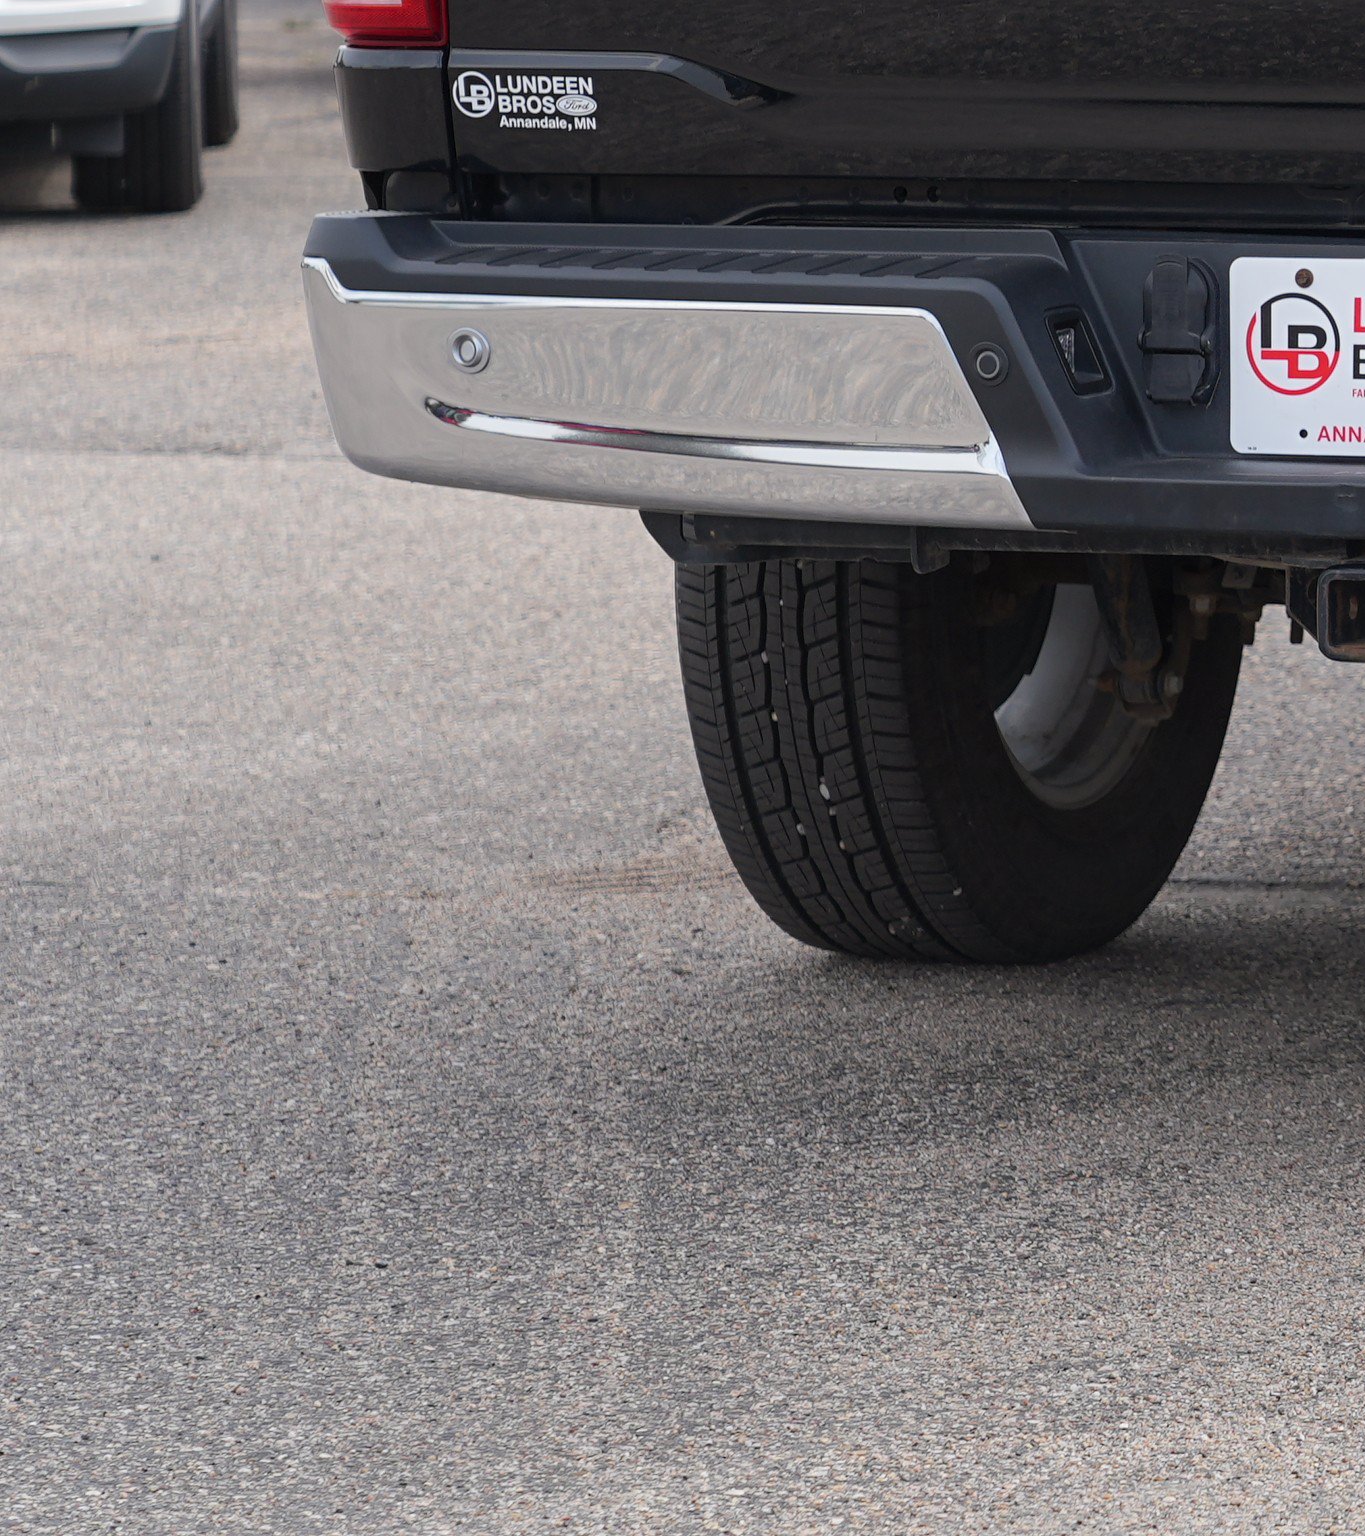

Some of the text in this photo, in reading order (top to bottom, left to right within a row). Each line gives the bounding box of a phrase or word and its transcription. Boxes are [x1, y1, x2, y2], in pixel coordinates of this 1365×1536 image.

[495, 74, 594, 95] LUNDEEN
[498, 95, 556, 114] BROS
[499, 115, 597, 132] Annandale, MN
